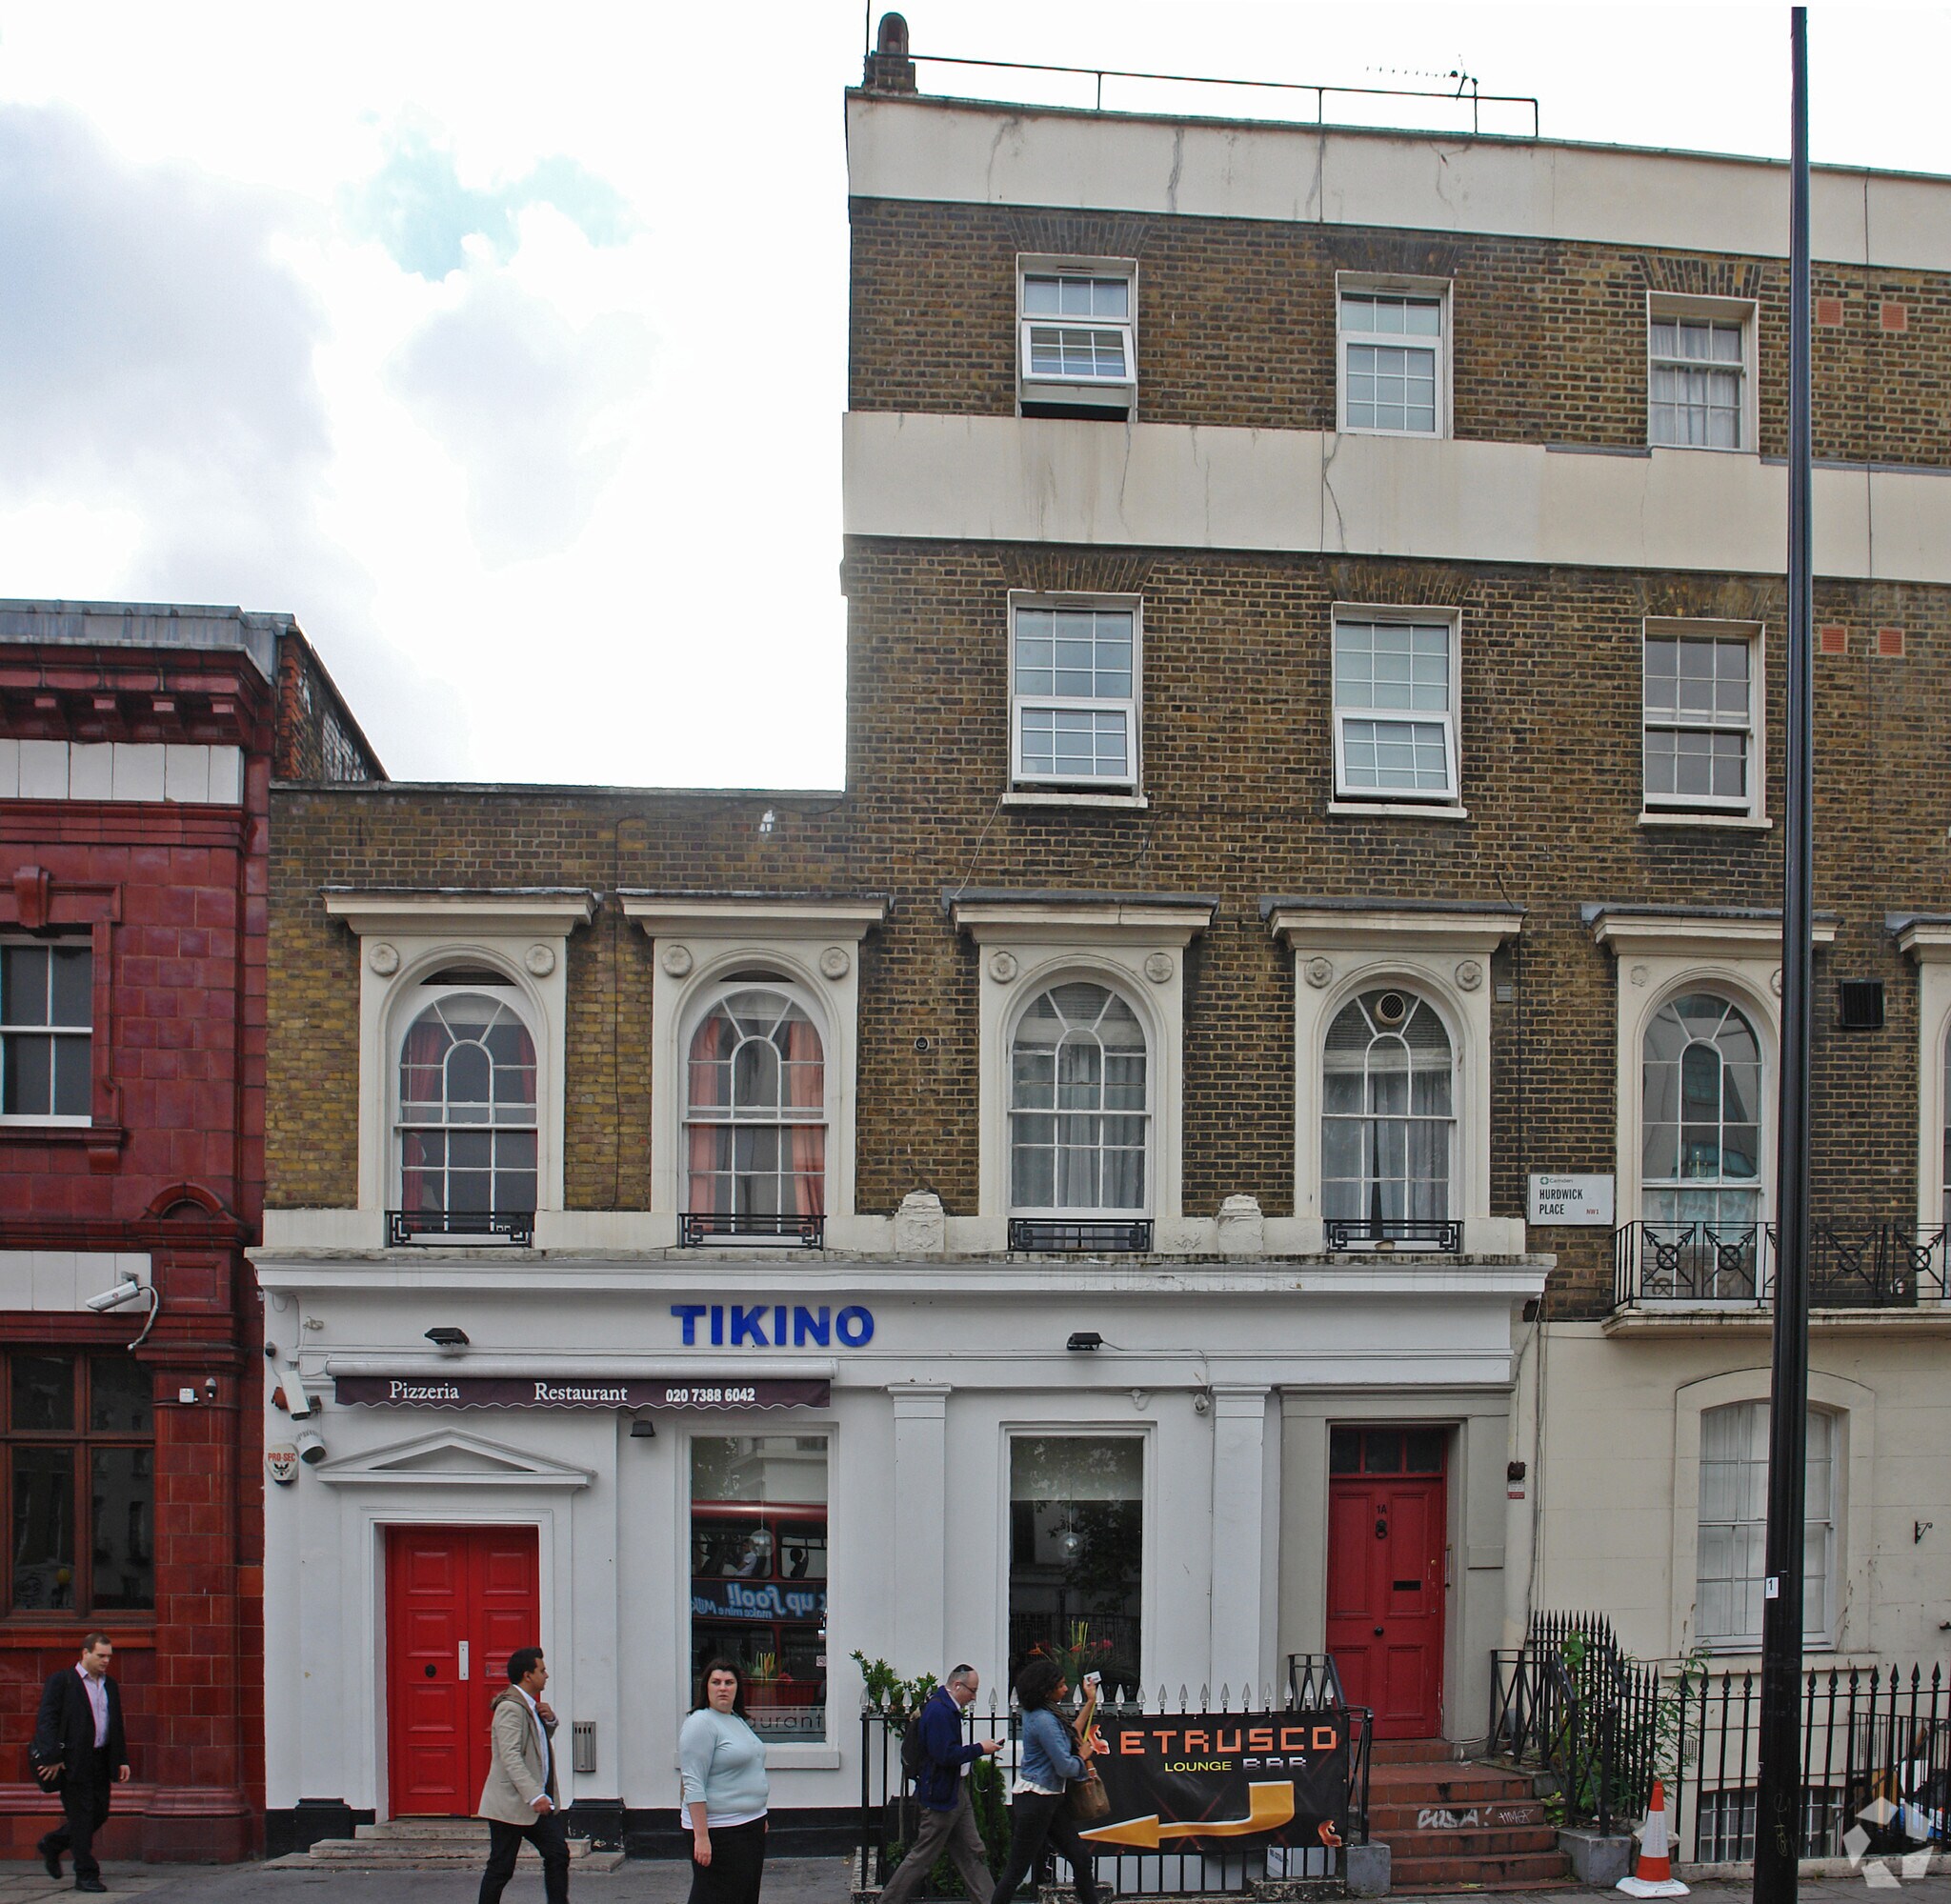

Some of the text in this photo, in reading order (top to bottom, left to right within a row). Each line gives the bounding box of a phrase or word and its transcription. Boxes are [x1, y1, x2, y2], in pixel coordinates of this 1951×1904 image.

[1539, 1189, 1583, 1200] HURDWICK
[1539, 1204, 1564, 1214] PLACE
[671, 1305, 875, 1347] TIKINO
[389, 1381, 755, 1402] Pizzeria Restaurant 020 7388 6042
[268, 1453, 296, 1462] PRO-SEC
[1377, 1504, 1387, 1514] 1A
[1768, 1578, 1773, 1591] 1
[747, 1714, 822, 1729] aurant
[1120, 1727, 1337, 1754] ETRUSCO
[1164, 1757, 1307, 1773] LOUNGE BAR
